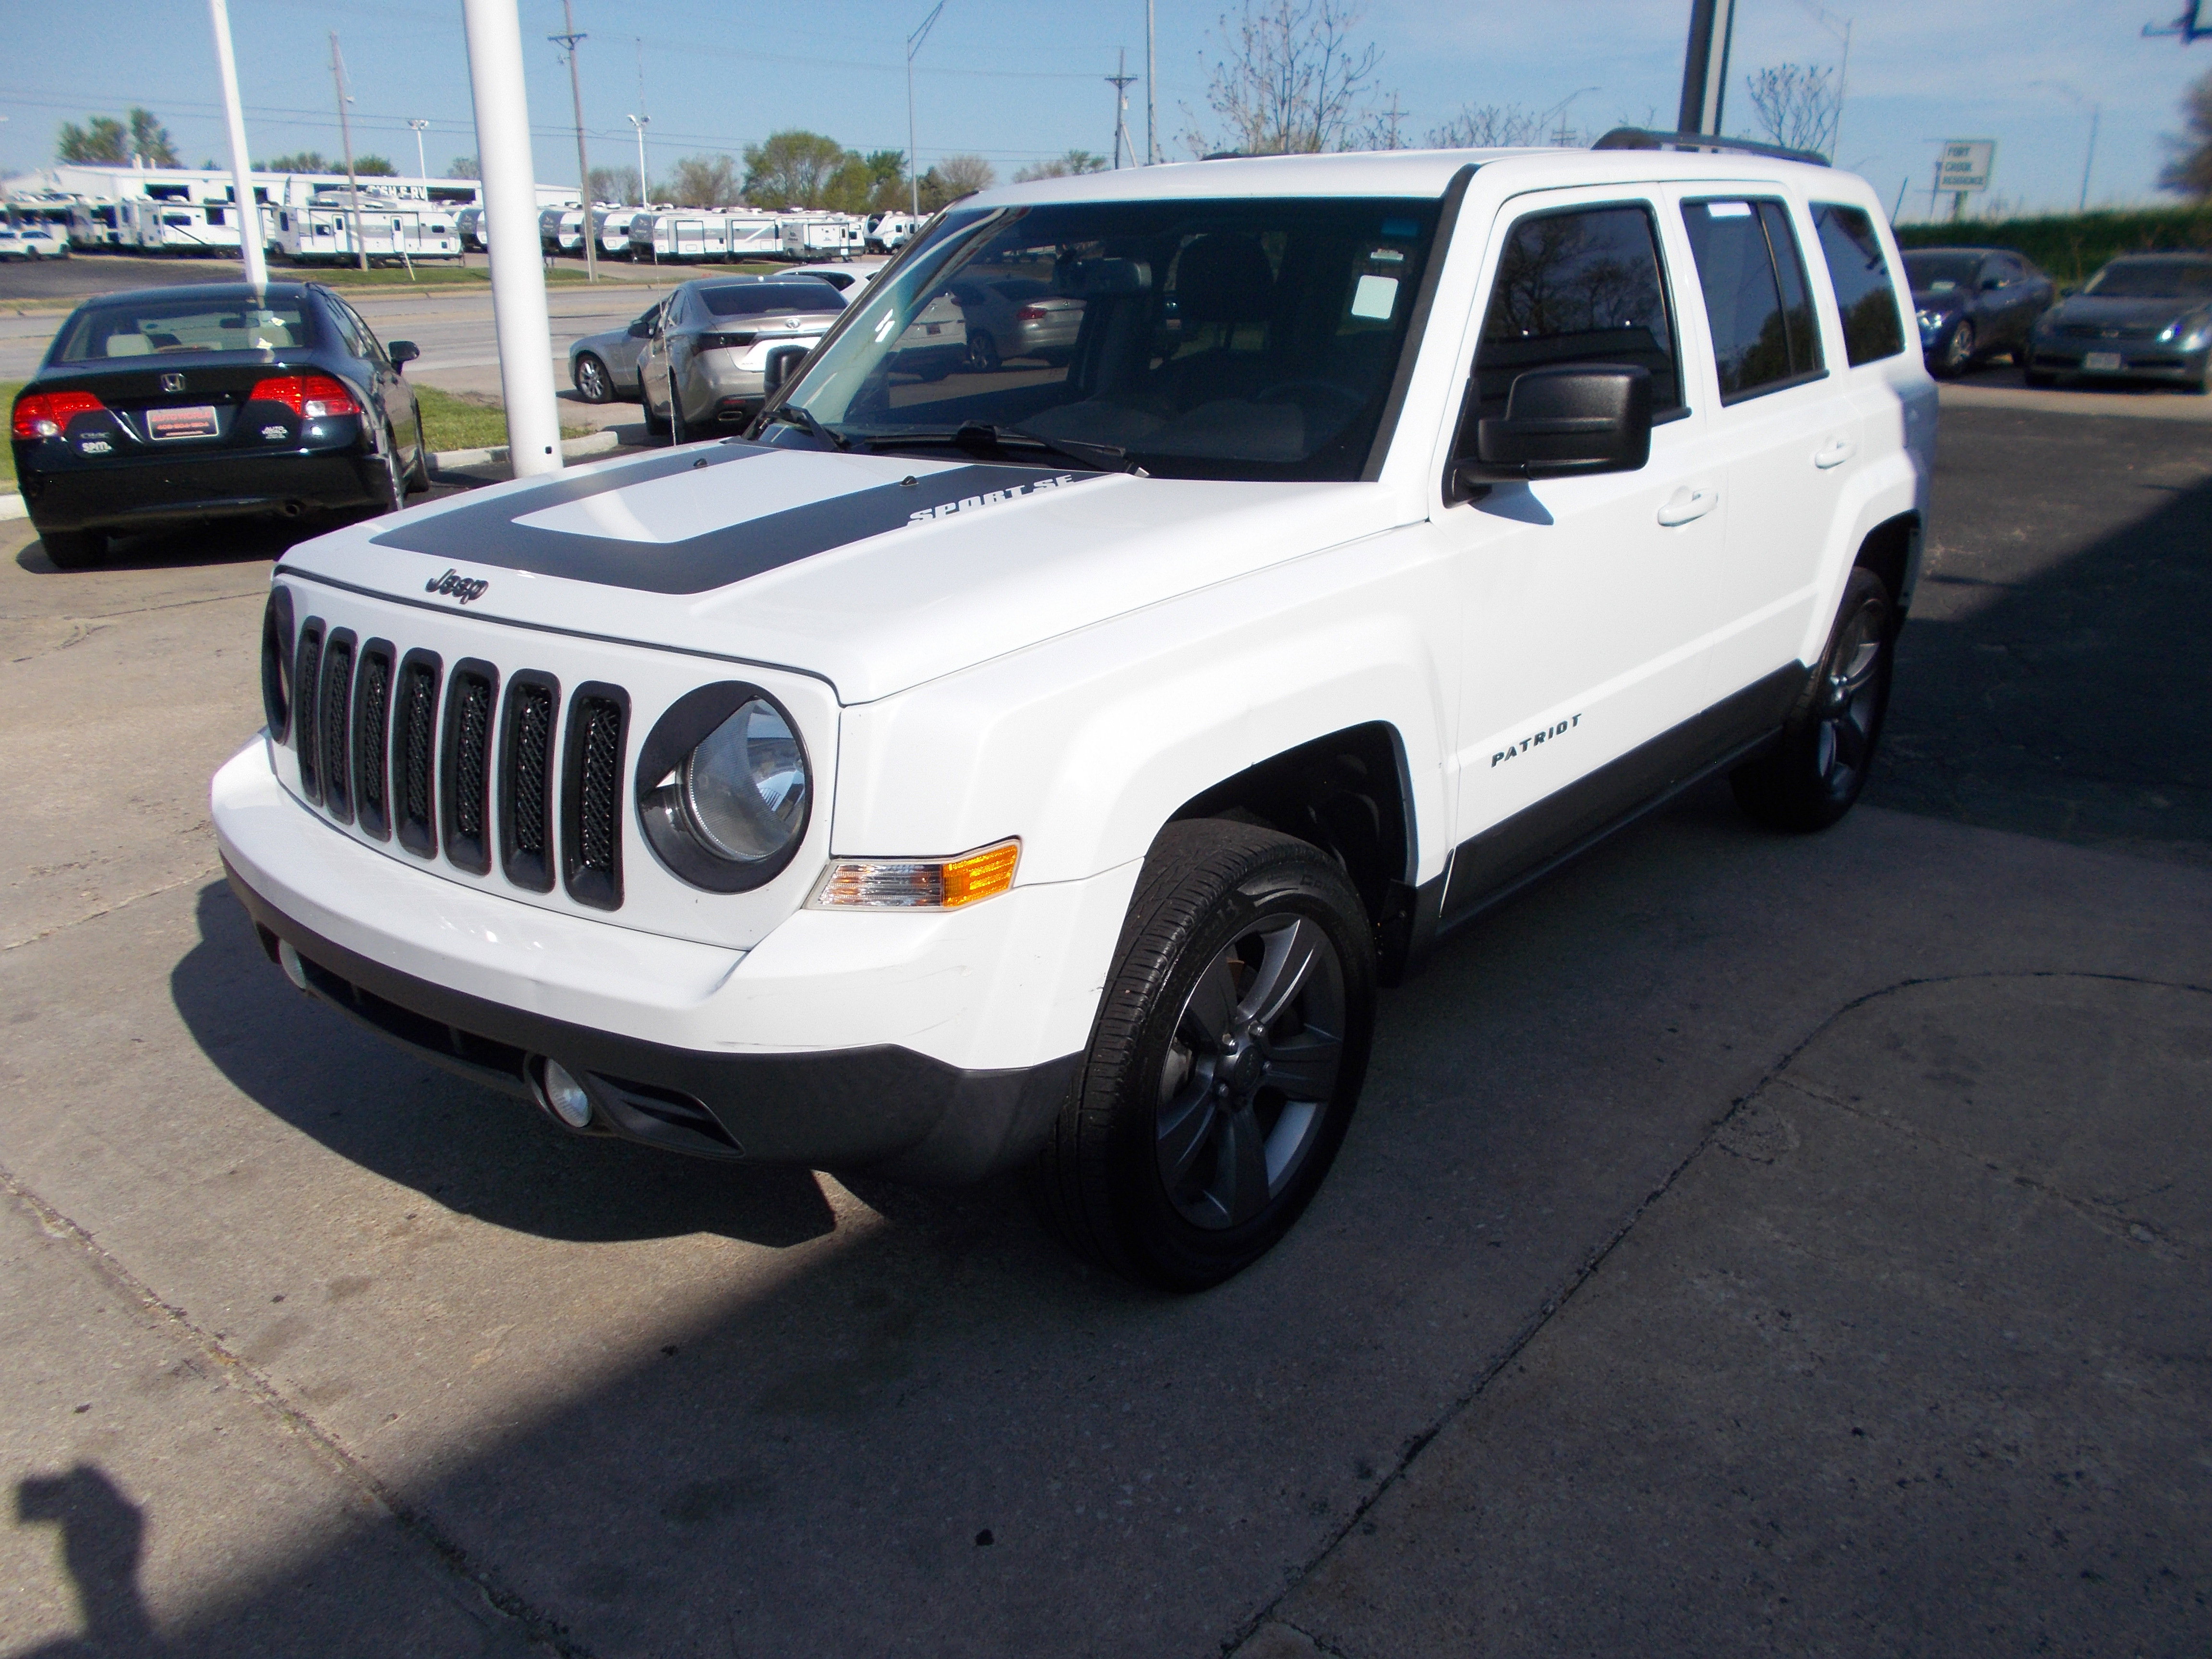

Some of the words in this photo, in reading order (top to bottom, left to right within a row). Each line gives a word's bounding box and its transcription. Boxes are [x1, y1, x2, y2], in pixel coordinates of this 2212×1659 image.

[410, 186, 426, 199] RV
[907, 485, 1025, 526] SPORT
[1032, 474, 1074, 493] SE
[425, 568, 489, 605] Jeep
[1491, 713, 1582, 768] PATRIOT
